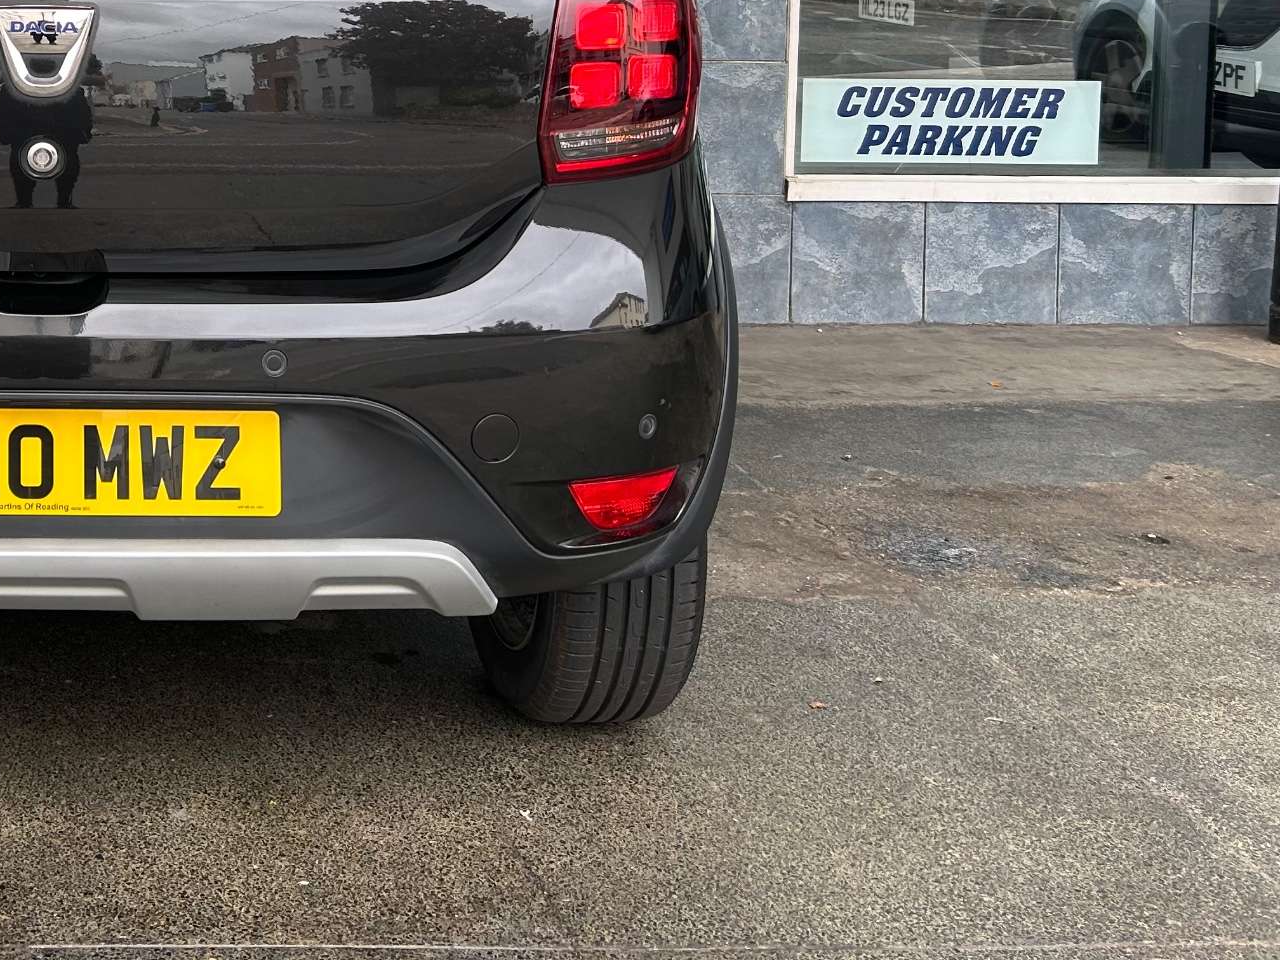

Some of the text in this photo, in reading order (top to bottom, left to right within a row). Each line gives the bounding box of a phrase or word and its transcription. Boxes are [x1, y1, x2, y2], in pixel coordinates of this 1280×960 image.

[9, 20, 79, 34] DACIA
[836, 86, 1066, 120] CUSTOMER
[856, 124, 1043, 157] PARKING
[83, 424, 241, 500] MWZ
[24, 503, 34, 511] Of
